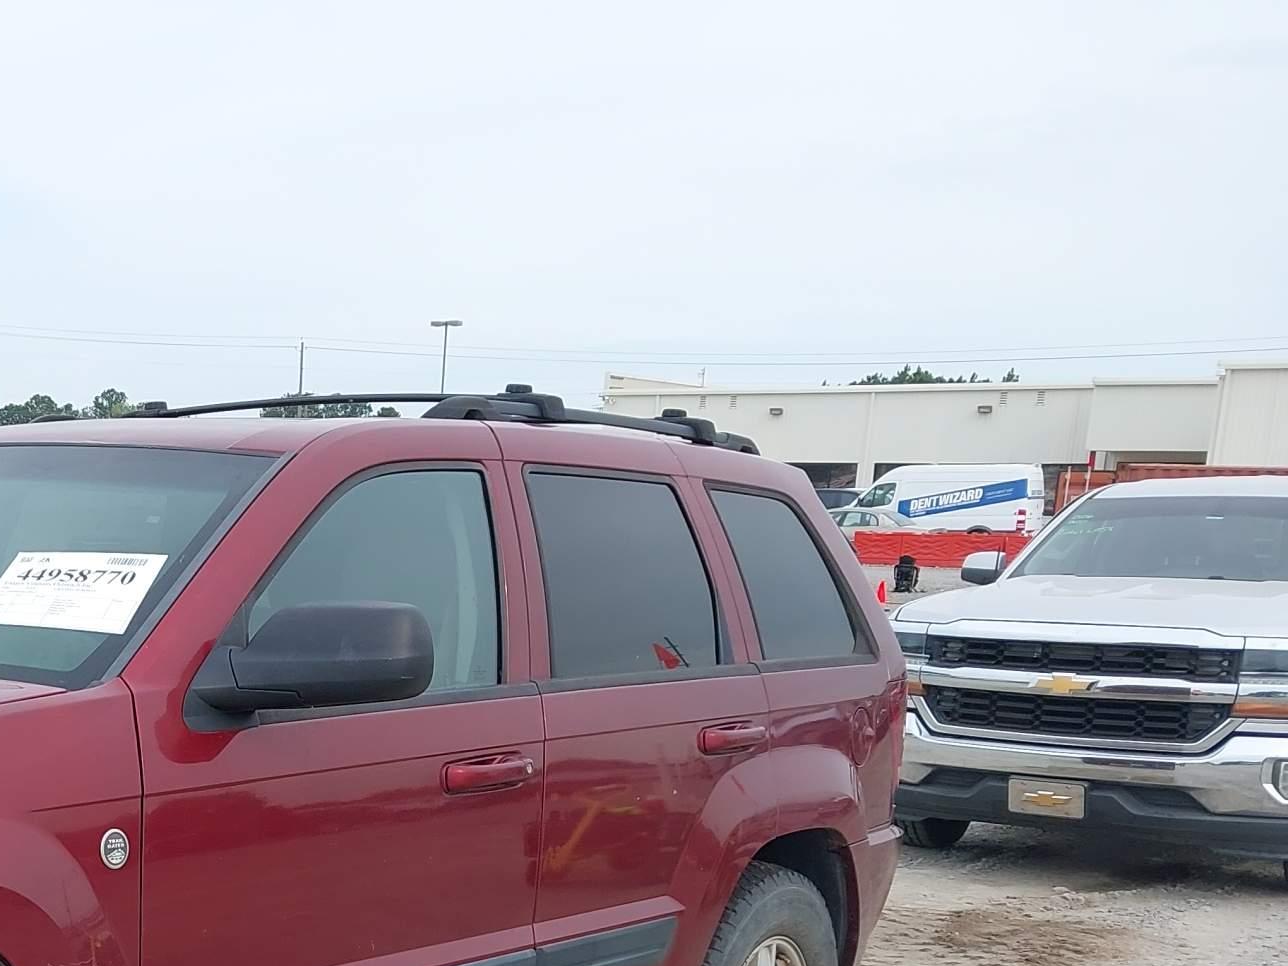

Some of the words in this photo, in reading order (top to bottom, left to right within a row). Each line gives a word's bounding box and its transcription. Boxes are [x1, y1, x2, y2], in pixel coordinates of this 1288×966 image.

[910, 495, 940, 511] DENT
[939, 488, 984, 506] WIZARD
[17, 568, 137, 585] 44958770
